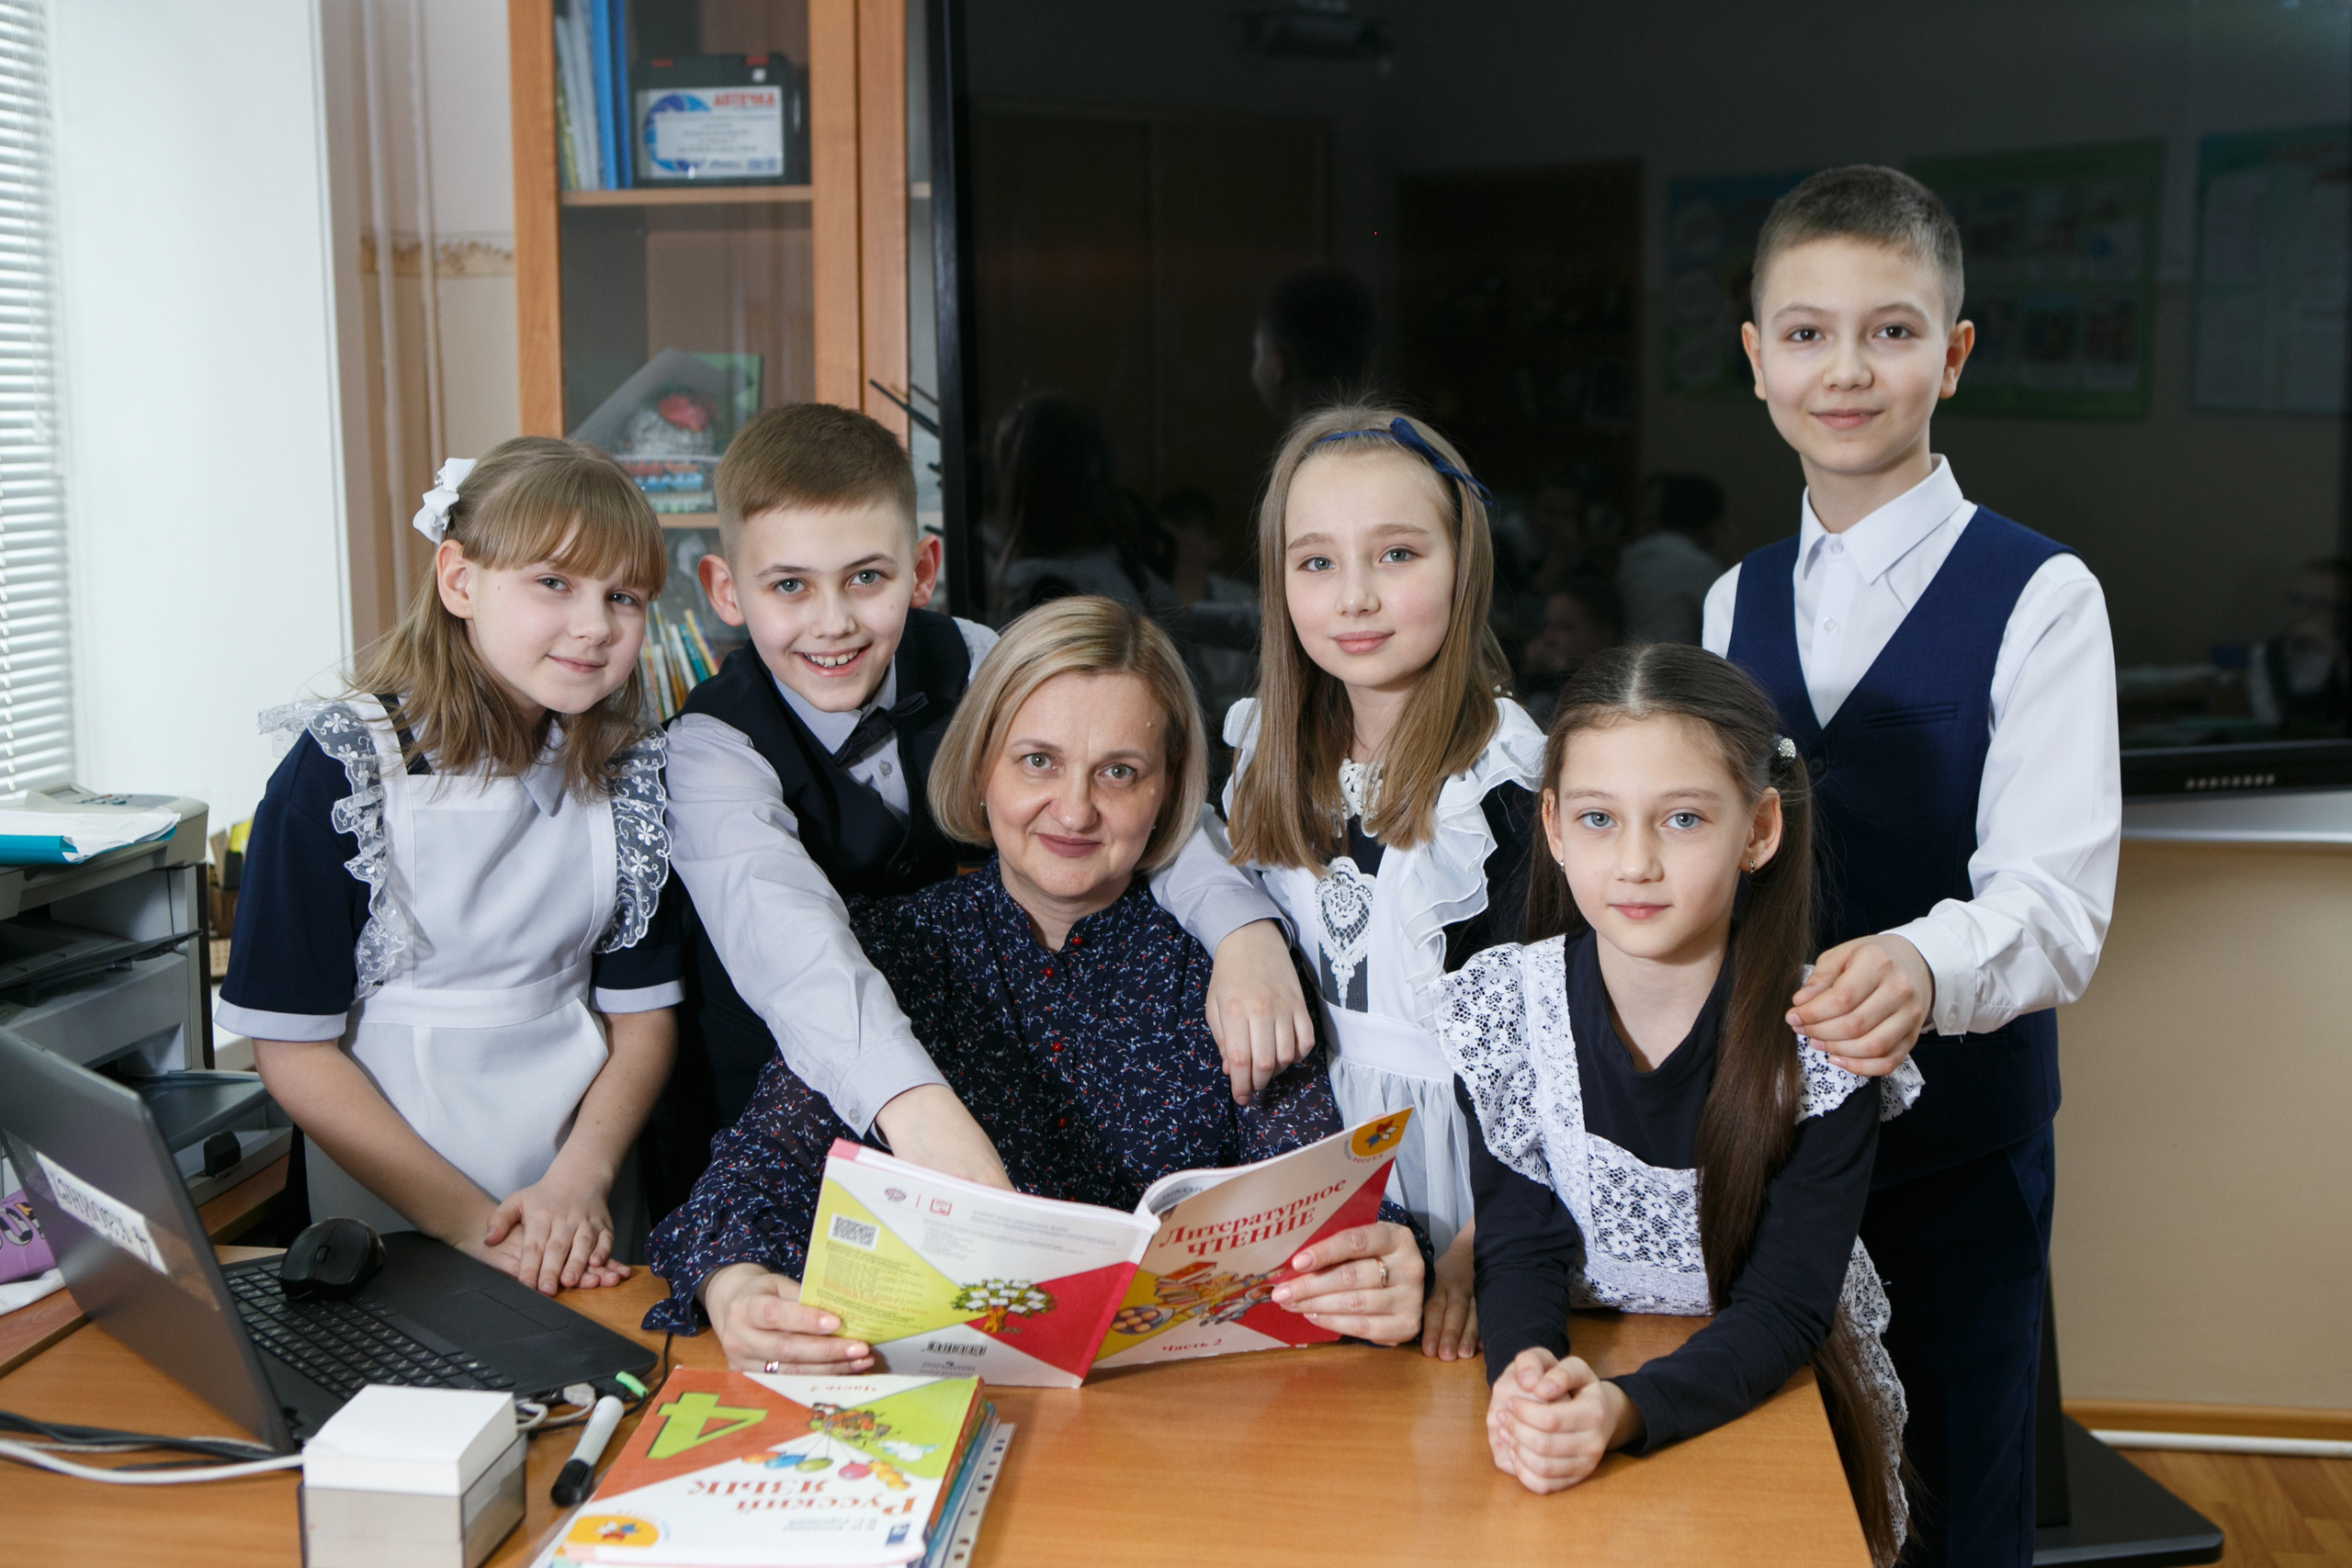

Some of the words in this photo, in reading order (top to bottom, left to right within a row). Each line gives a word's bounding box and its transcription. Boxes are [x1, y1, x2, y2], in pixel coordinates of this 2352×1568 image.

[1159, 1179, 1347, 1248] Литературное
[1187, 1207, 1316, 1258] ЧТЕНИЕ
[1162, 1342, 1208, 1352] Часть
[646, 1392, 769, 1459] 4
[734, 1494, 919, 1516] Русский
